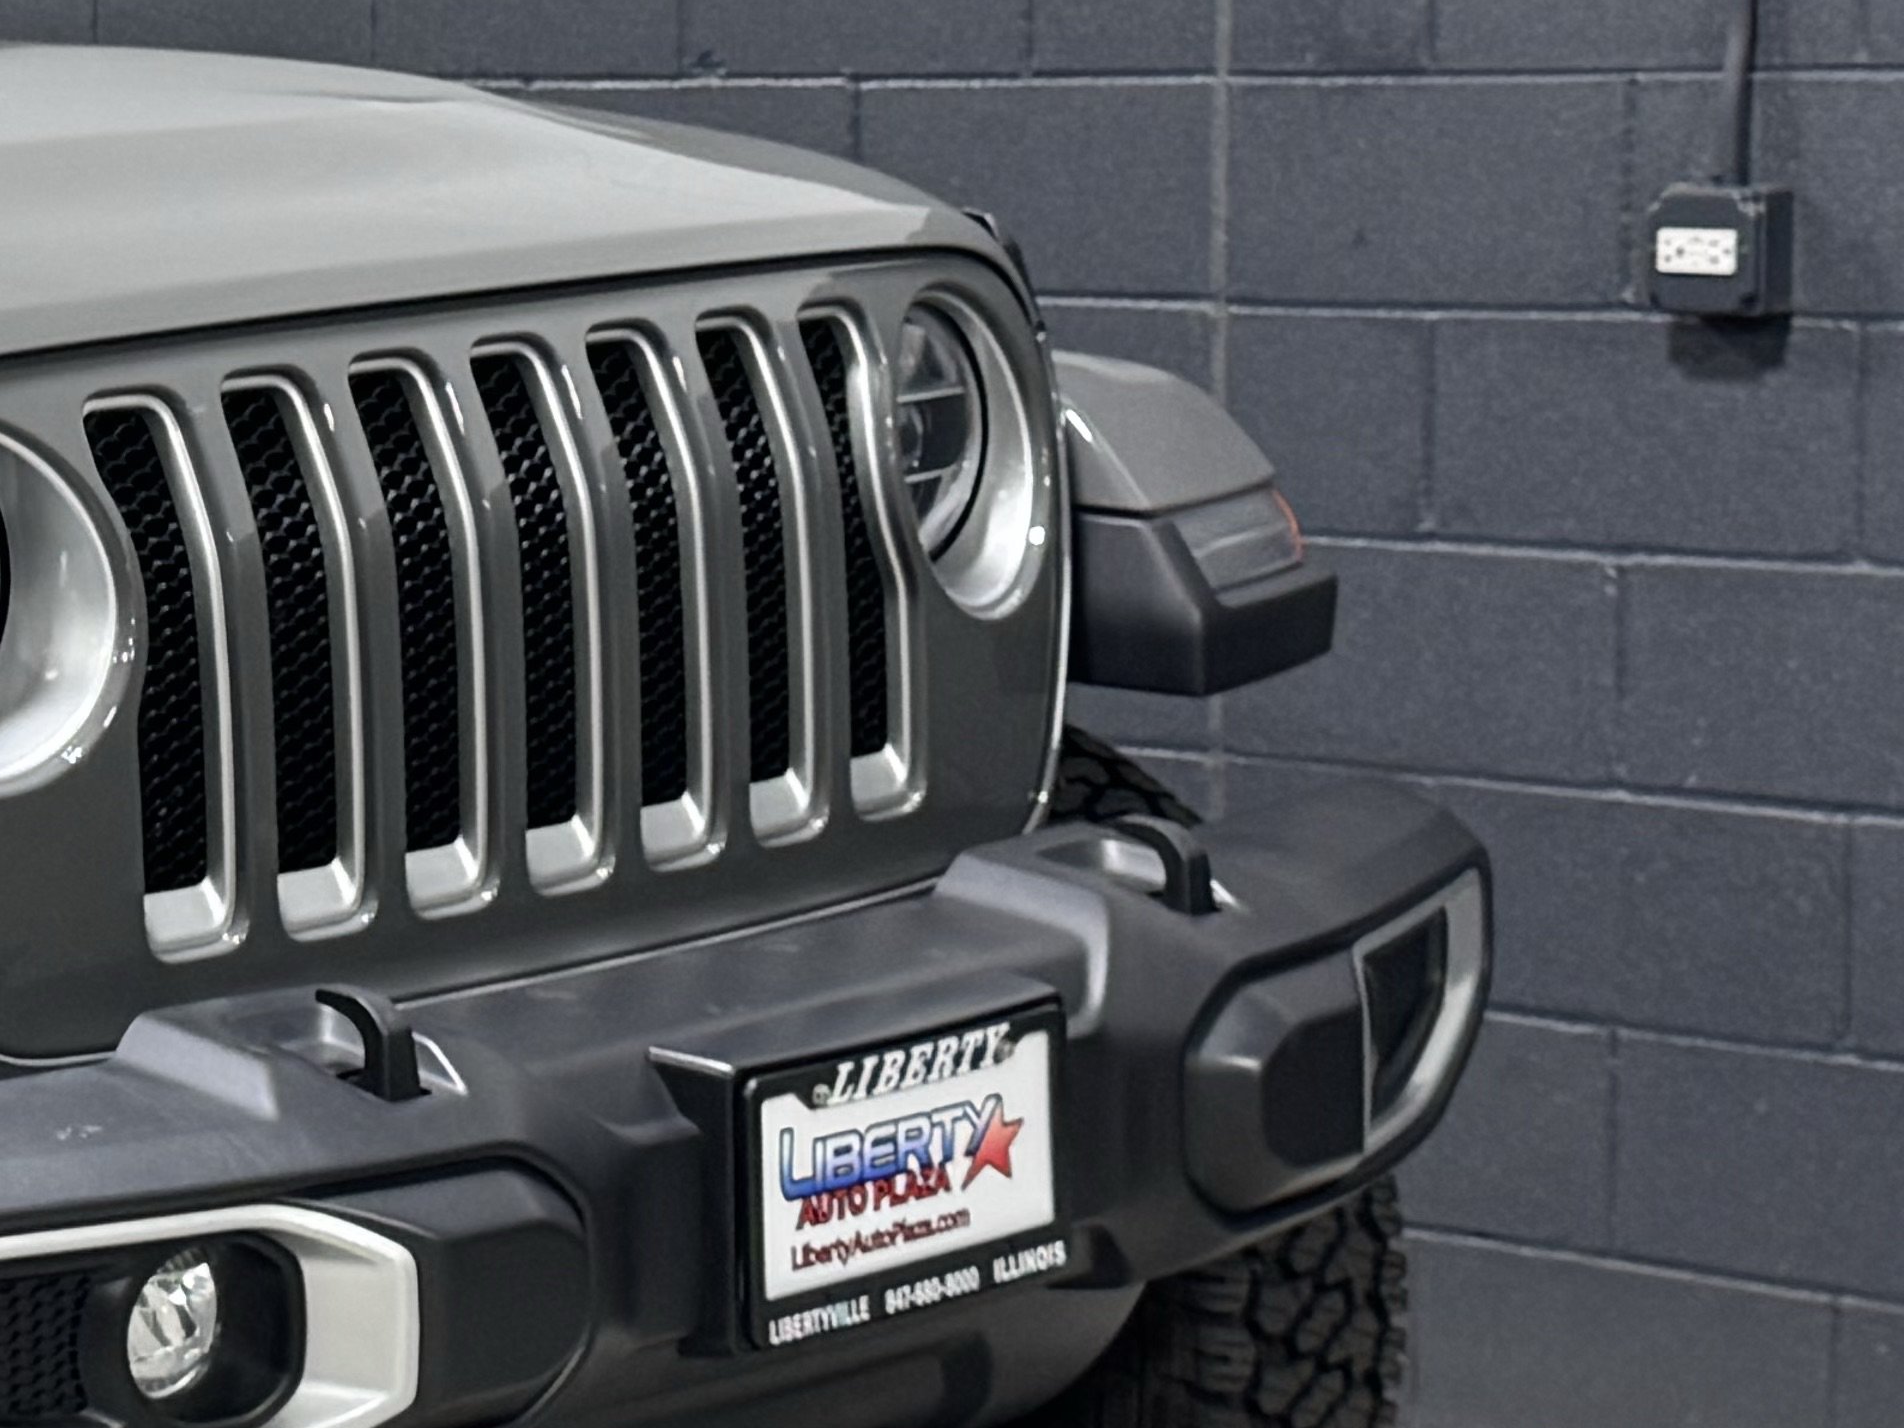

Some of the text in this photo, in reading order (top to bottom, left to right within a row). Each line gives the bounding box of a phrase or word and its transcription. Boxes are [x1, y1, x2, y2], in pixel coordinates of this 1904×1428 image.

[827, 1022, 1012, 1105] LIBERTY
[779, 1092, 1004, 1202] LIBERTY
[796, 1164, 952, 1230] AUTO PLAZA
[769, 1294, 871, 1345] LIBERTYVILLE
[993, 1240, 1067, 1284] ILLINOIS
